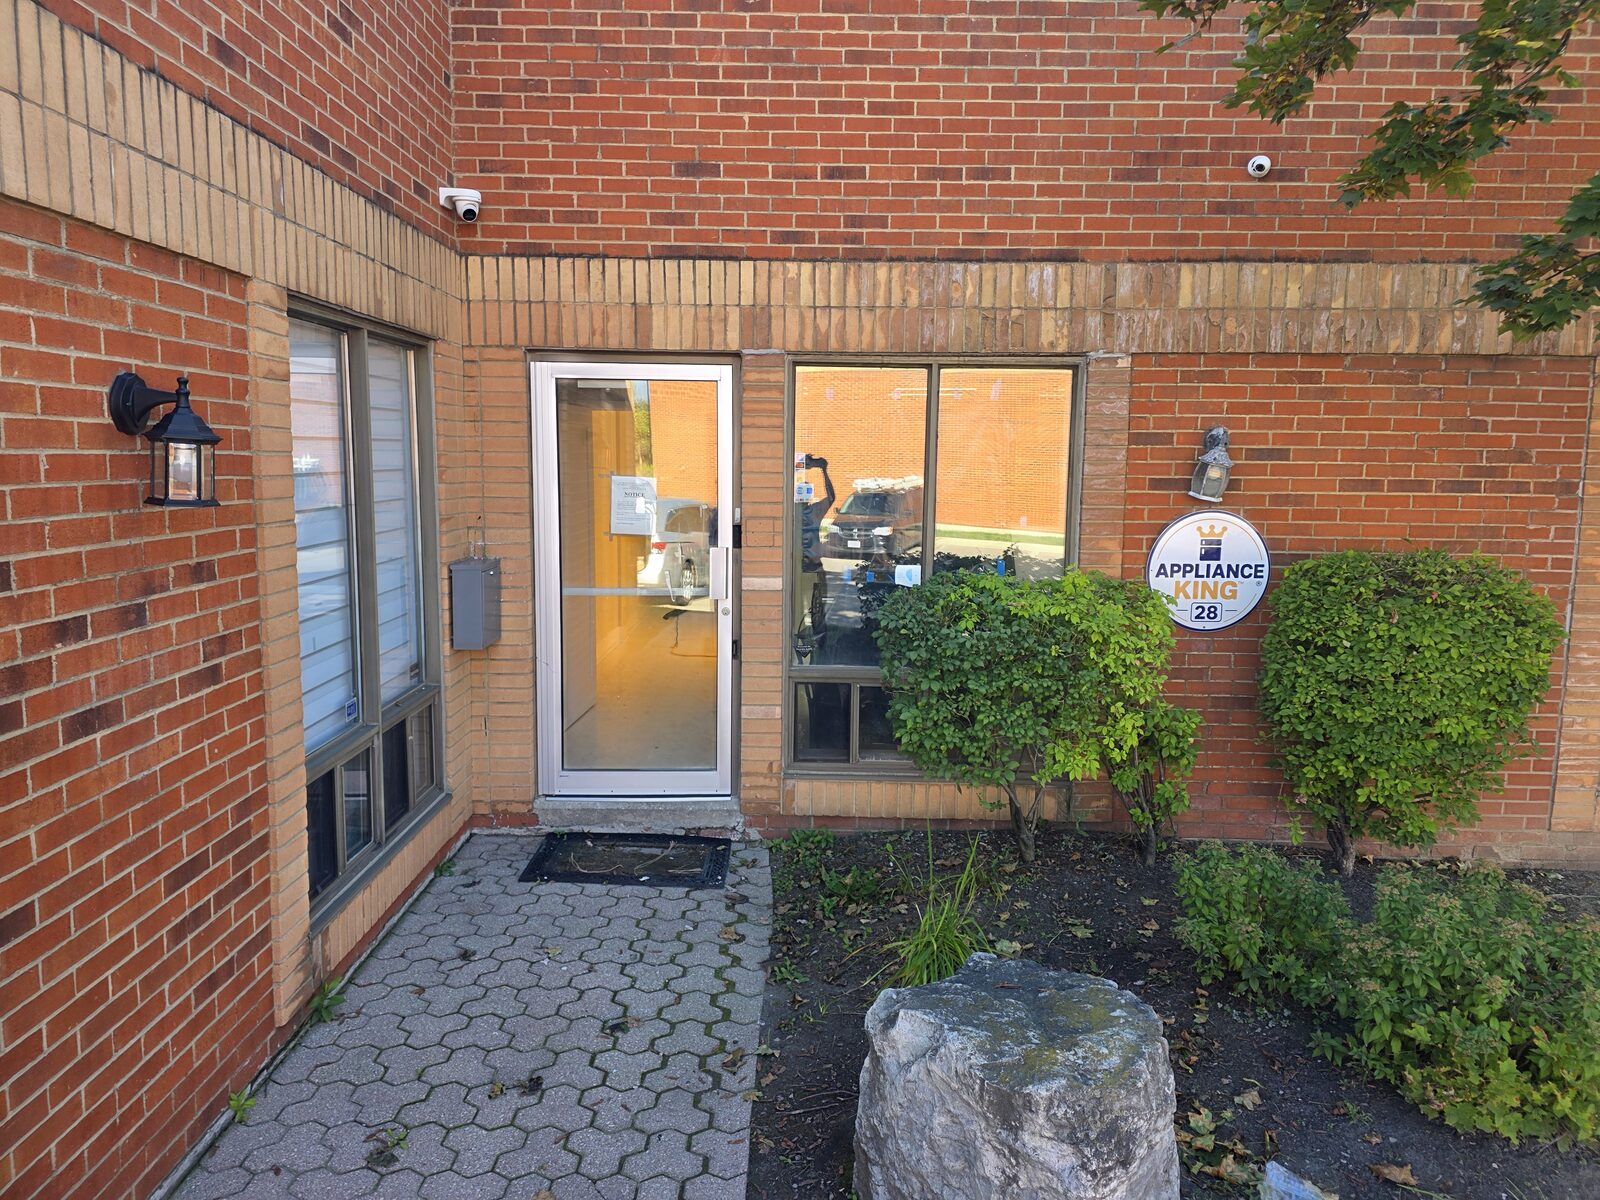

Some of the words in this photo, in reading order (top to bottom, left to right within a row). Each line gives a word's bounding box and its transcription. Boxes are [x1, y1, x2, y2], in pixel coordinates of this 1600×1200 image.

[1155, 563, 1265, 579] APPLIANCE
[1174, 580, 1238, 600] KING
[1194, 605, 1218, 620] 28
